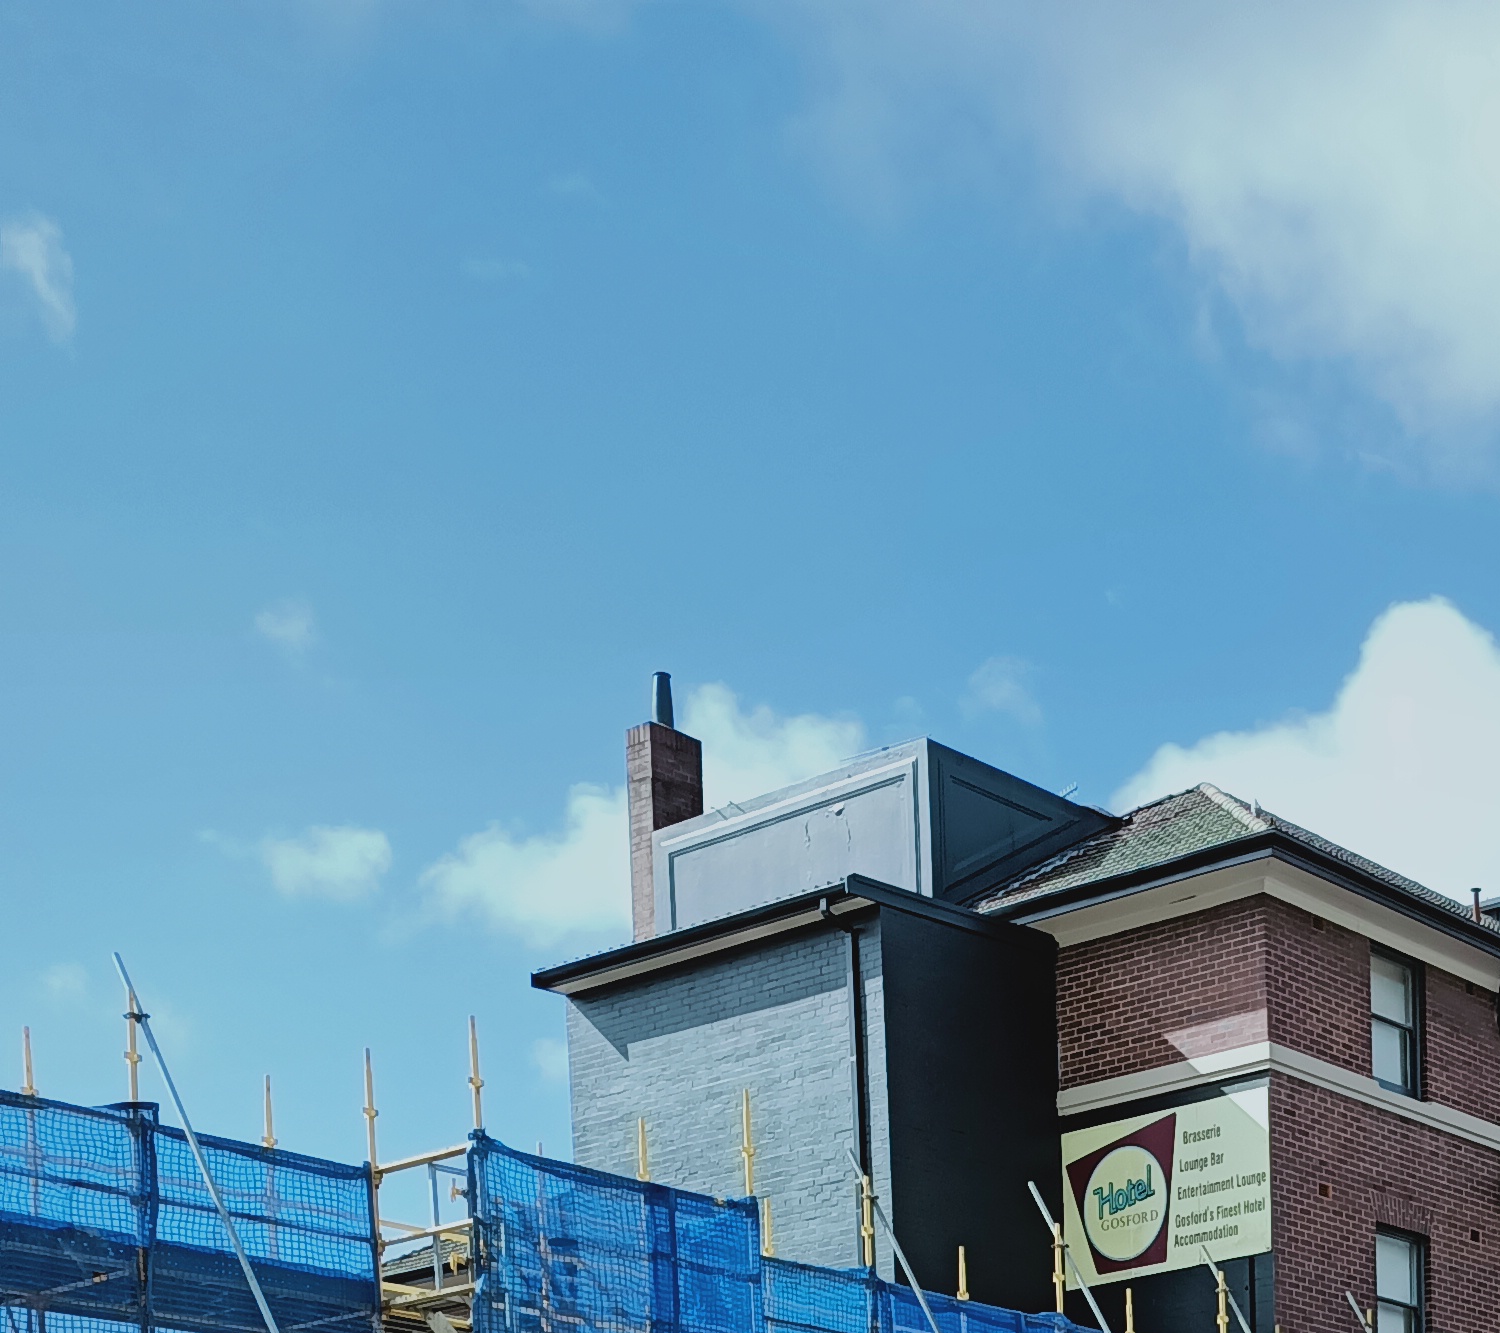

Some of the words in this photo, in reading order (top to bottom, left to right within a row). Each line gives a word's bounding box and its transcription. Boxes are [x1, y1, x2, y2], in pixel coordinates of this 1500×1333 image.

[1183, 1124, 1221, 1145] Brasserie
[1179, 1156, 1208, 1173] Lounge
[1210, 1152, 1224, 1166] Bar
[1093, 1164, 1155, 1221] Hotel
[1177, 1180, 1234, 1201] Entertainment
[1236, 1171, 1267, 1188] Lounge
[1101, 1209, 1159, 1232] GOSFORD
[1175, 1206, 1215, 1229] Gosford's
[1216, 1202, 1242, 1221] Finest
[1243, 1197, 1266, 1216] Hotel
[1174, 1224, 1239, 1248] Accommodation
